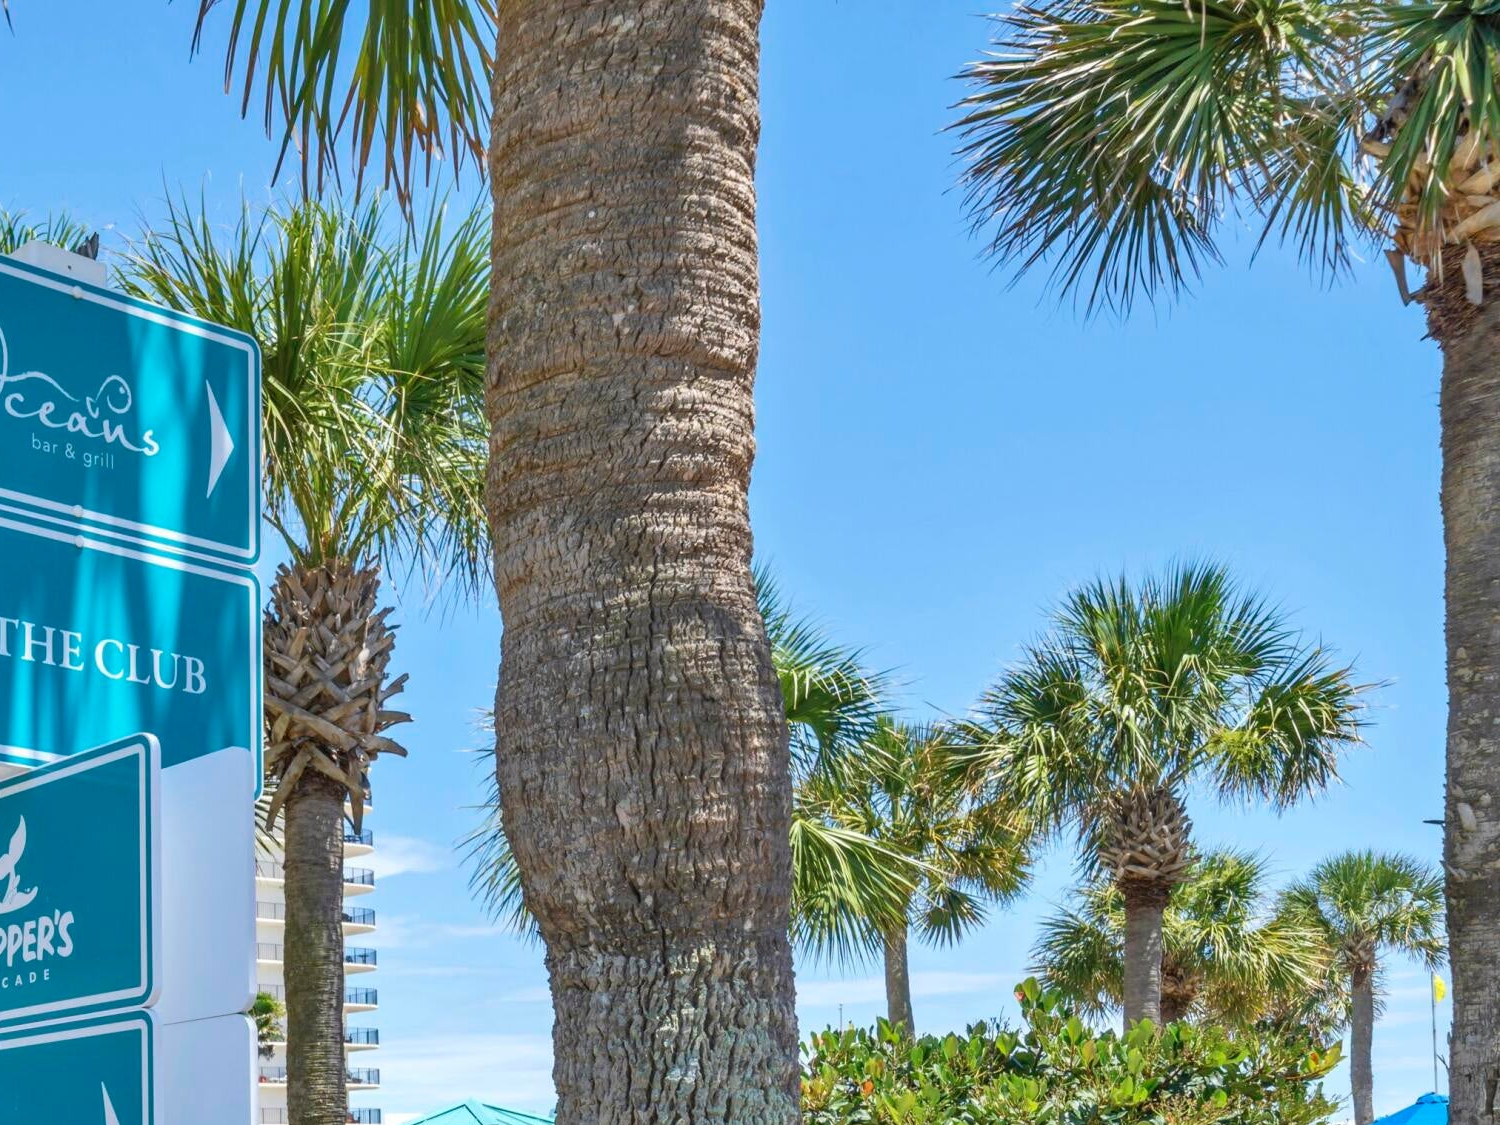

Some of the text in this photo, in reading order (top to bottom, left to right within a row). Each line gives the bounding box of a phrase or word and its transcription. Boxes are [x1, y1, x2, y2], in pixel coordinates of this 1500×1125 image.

[31, 432, 115, 470] bar & grill
[94, 639, 206, 695] CLUB
